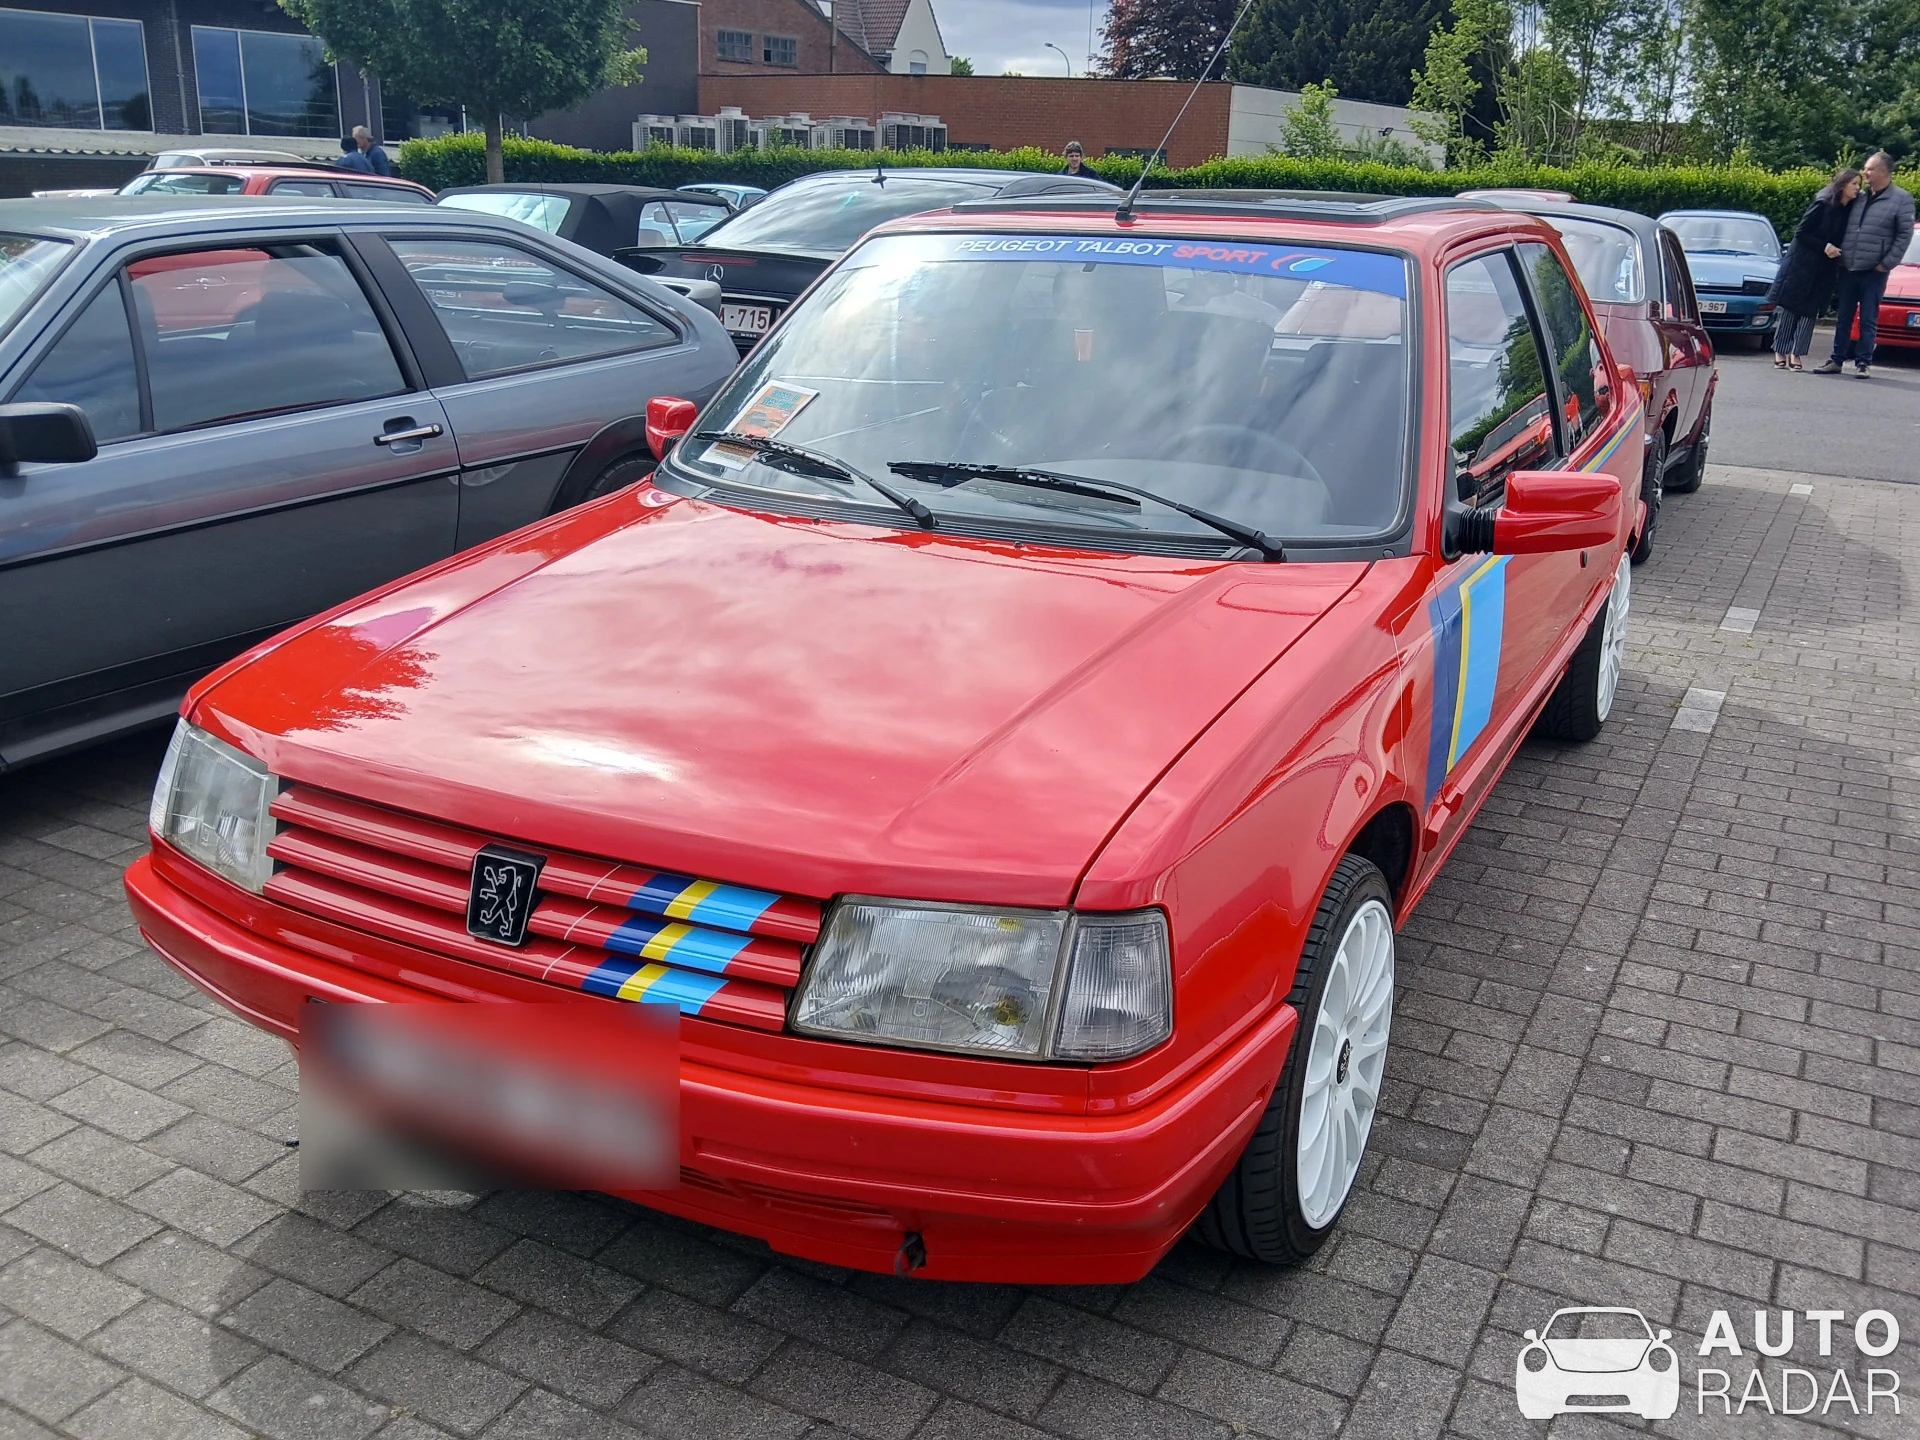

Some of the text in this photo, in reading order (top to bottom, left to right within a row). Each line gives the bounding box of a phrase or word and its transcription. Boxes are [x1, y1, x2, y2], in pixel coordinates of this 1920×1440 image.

[953, 240, 1269, 264] PEUGEOT TALBOT SPORT
